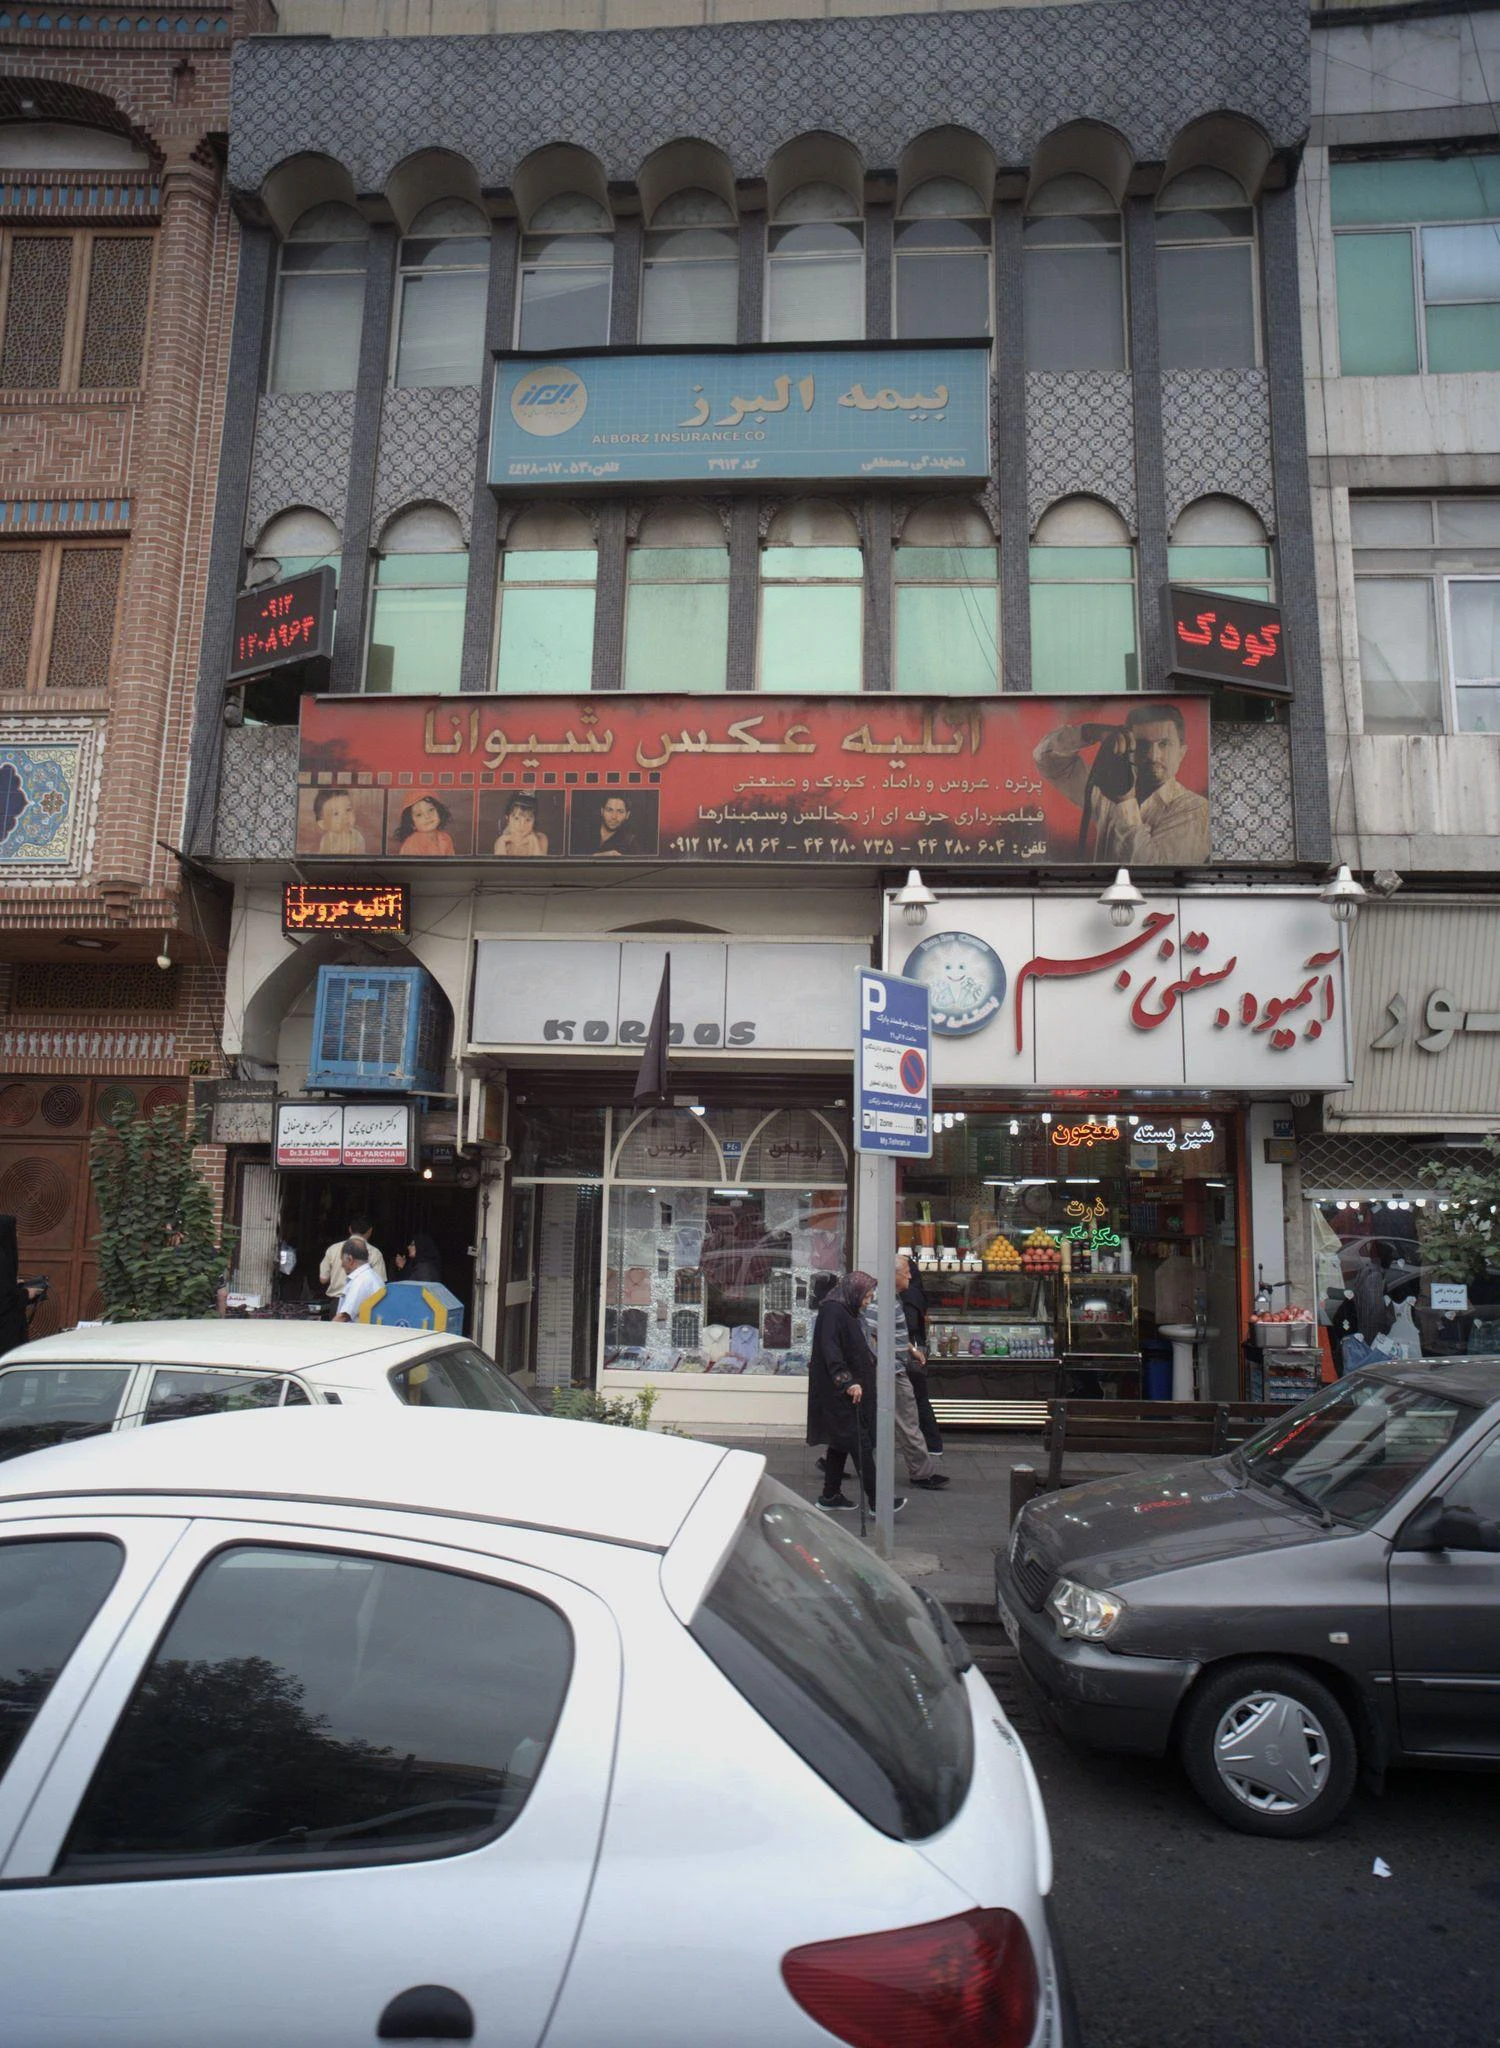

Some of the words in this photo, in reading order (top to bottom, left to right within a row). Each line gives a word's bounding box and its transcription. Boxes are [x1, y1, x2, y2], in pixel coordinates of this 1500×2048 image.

[678, 372, 816, 428] البرز
[837, 384, 950, 422] بیمه
[592, 433, 650, 445] ALBORZ
[654, 431, 741, 444] INSURANCE
[745, 431, 766, 441] CO
[1177, 611, 1281, 668] کودک
[424, 706, 614, 770] شیوانا
[635, 715, 817, 769] عکس
[732, 775, 797, 793] صنعتی
[801, 777, 810, 792] و
[814, 775, 867, 793] کودک
[881, 774, 921, 789] داماد
[926, 778, 935, 793] و
[939, 777, 990, 793] عروس
[1005, 775, 1043, 796] پرتره
[792, 805, 859, 825] مجالس
[862, 806, 876, 826] از
[904, 806, 950, 826] حرفه
[953, 806, 1046, 826] فیلمبرداری
[862, 977, 888, 1032] P
[317, 1109, 339, 1133] دکتر
[382, 1109, 402, 1133] دکتر
[1051, 1121, 1121, 1147] معجون
[1133, 1123, 1176, 1152] پسته
[1180, 1120, 1215, 1150] شیر
[1066, 1196, 1106, 1222] ذرت
